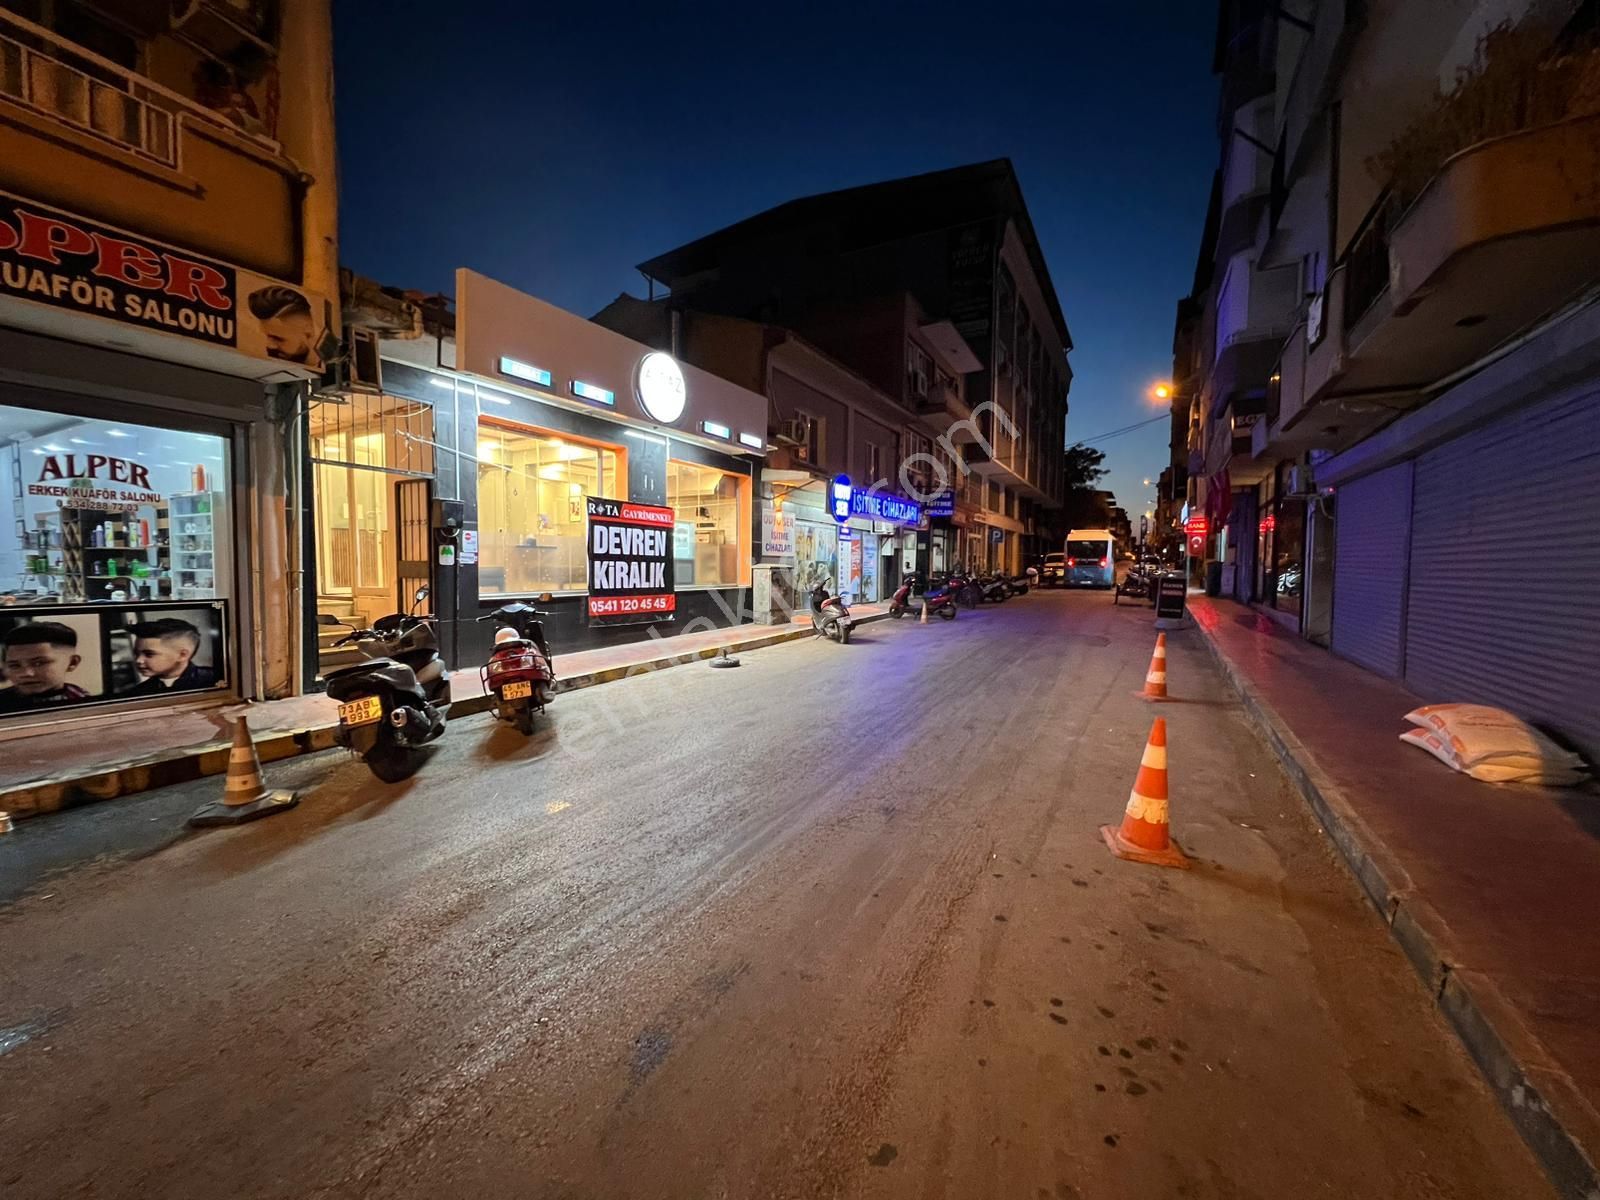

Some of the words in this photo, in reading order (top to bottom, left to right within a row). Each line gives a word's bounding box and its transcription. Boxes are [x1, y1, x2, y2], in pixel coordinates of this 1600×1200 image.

[0, 208, 232, 310] PER
[0, 260, 116, 312] UAFÖR
[124, 294, 234, 340] SALONU
[38, 454, 153, 491] ALPER
[28, 484, 69, 497] ERKEK
[72, 487, 117, 501] KUAFÖR
[120, 491, 161, 503] SALONU
[593, 525, 667, 557] DEVREN
[591, 600, 618, 613] 0541
[620, 599, 638, 610] 120
[640, 599, 653, 609] 45
[654, 598, 666, 609] 45
[349, 710, 371, 723] 993
